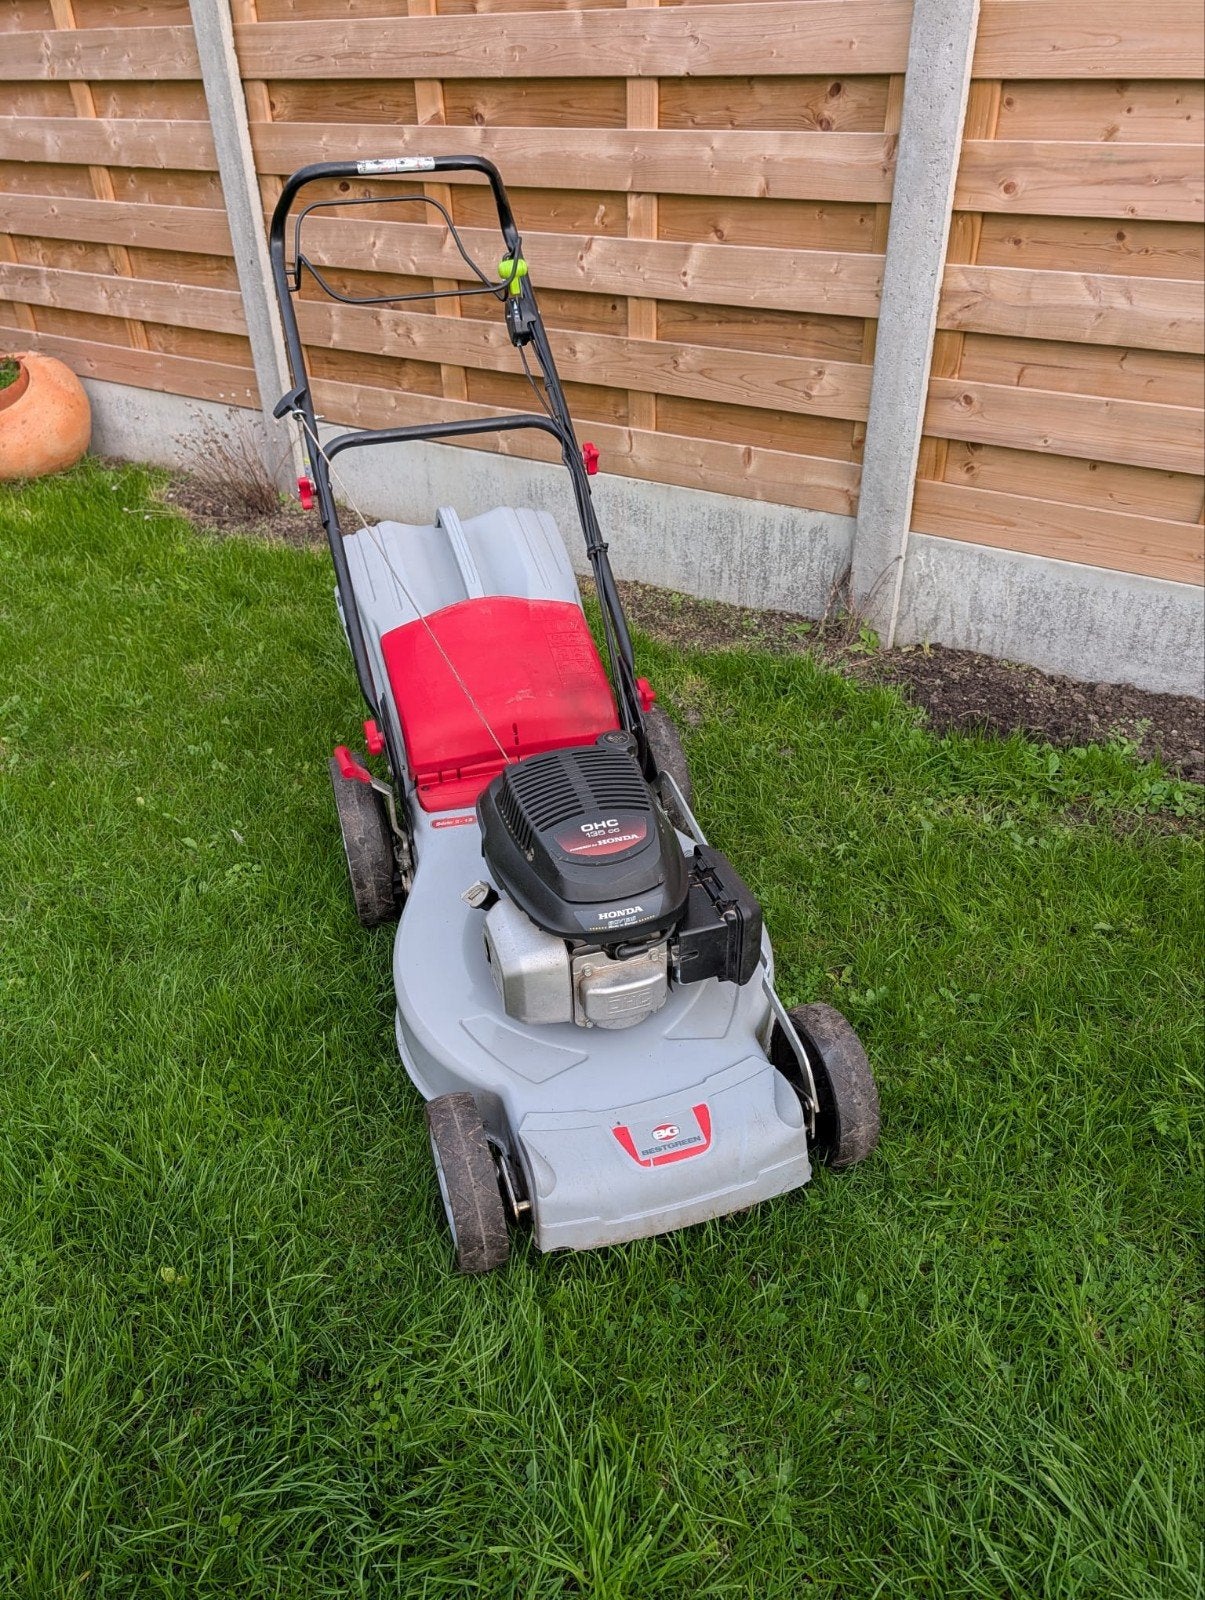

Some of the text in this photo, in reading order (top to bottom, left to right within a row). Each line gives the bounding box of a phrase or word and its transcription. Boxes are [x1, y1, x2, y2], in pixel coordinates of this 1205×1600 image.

[580, 819, 619, 832] OHC
[585, 829, 606, 838] 135
[597, 834, 639, 846] HONDA
[598, 905, 644, 920] HONDA
[641, 1136, 701, 1156] BESTGREEN
